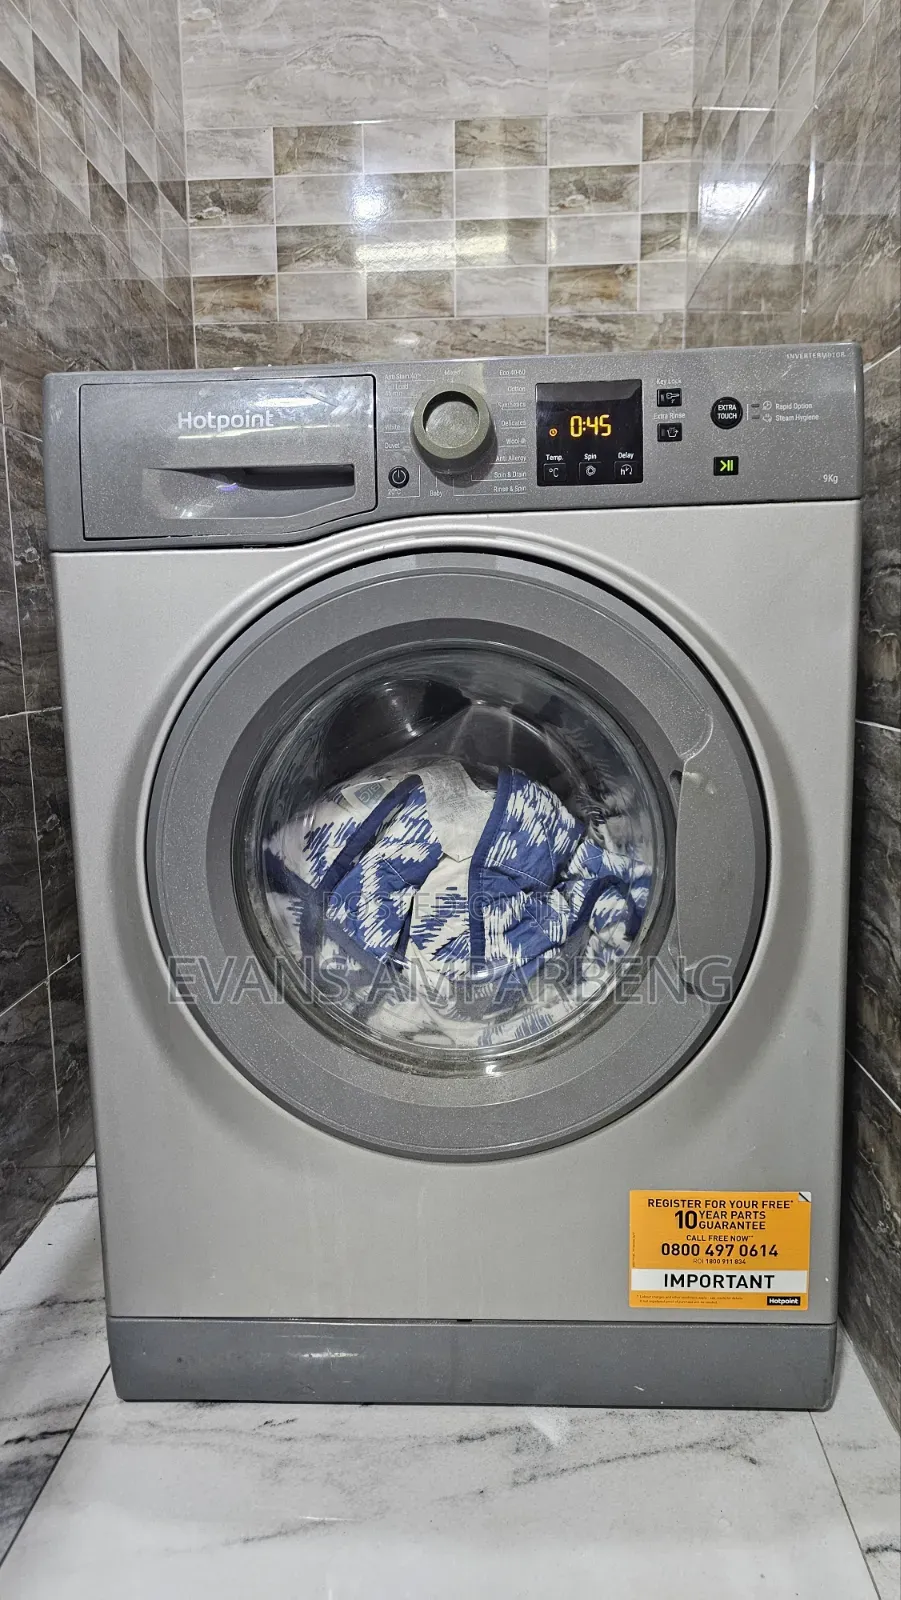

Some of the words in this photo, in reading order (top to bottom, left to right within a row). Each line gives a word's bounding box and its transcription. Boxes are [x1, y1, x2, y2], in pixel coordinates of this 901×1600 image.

[775, 403, 792, 411] Rapid
[793, 402, 813, 411] Option
[717, 412, 738, 420] TOUCH
[775, 414, 795, 422] Steam
[795, 413, 820, 422] Hygiene
[177, 409, 275, 433] Hotpoint
[569, 414, 612, 438] 0:45
[384, 442, 401, 450] Duvet
[618, 451, 634, 460] Delay
[822, 473, 839, 484] 9Kg
[429, 489, 443, 498] Baby
[647, 1198, 702, 1209] REGISTER
[704, 1199, 727, 1209] FOR
[729, 1200, 759, 1209] YOUR
[674, 1209, 698, 1230] 10
[698, 1210, 728, 1220] YEAR
[730, 1210, 766, 1220] PARTS
[698, 1220, 766, 1230] GUARANTEE
[686, 1234, 706, 1242] CALL
[661, 1242, 700, 1257] 0800
[704, 1243, 735, 1257] 497
[738, 1244, 779, 1258] 0614
[664, 1273, 776, 1289] IMPORTANT
[768, 1297, 799, 1305] Hotpoint
